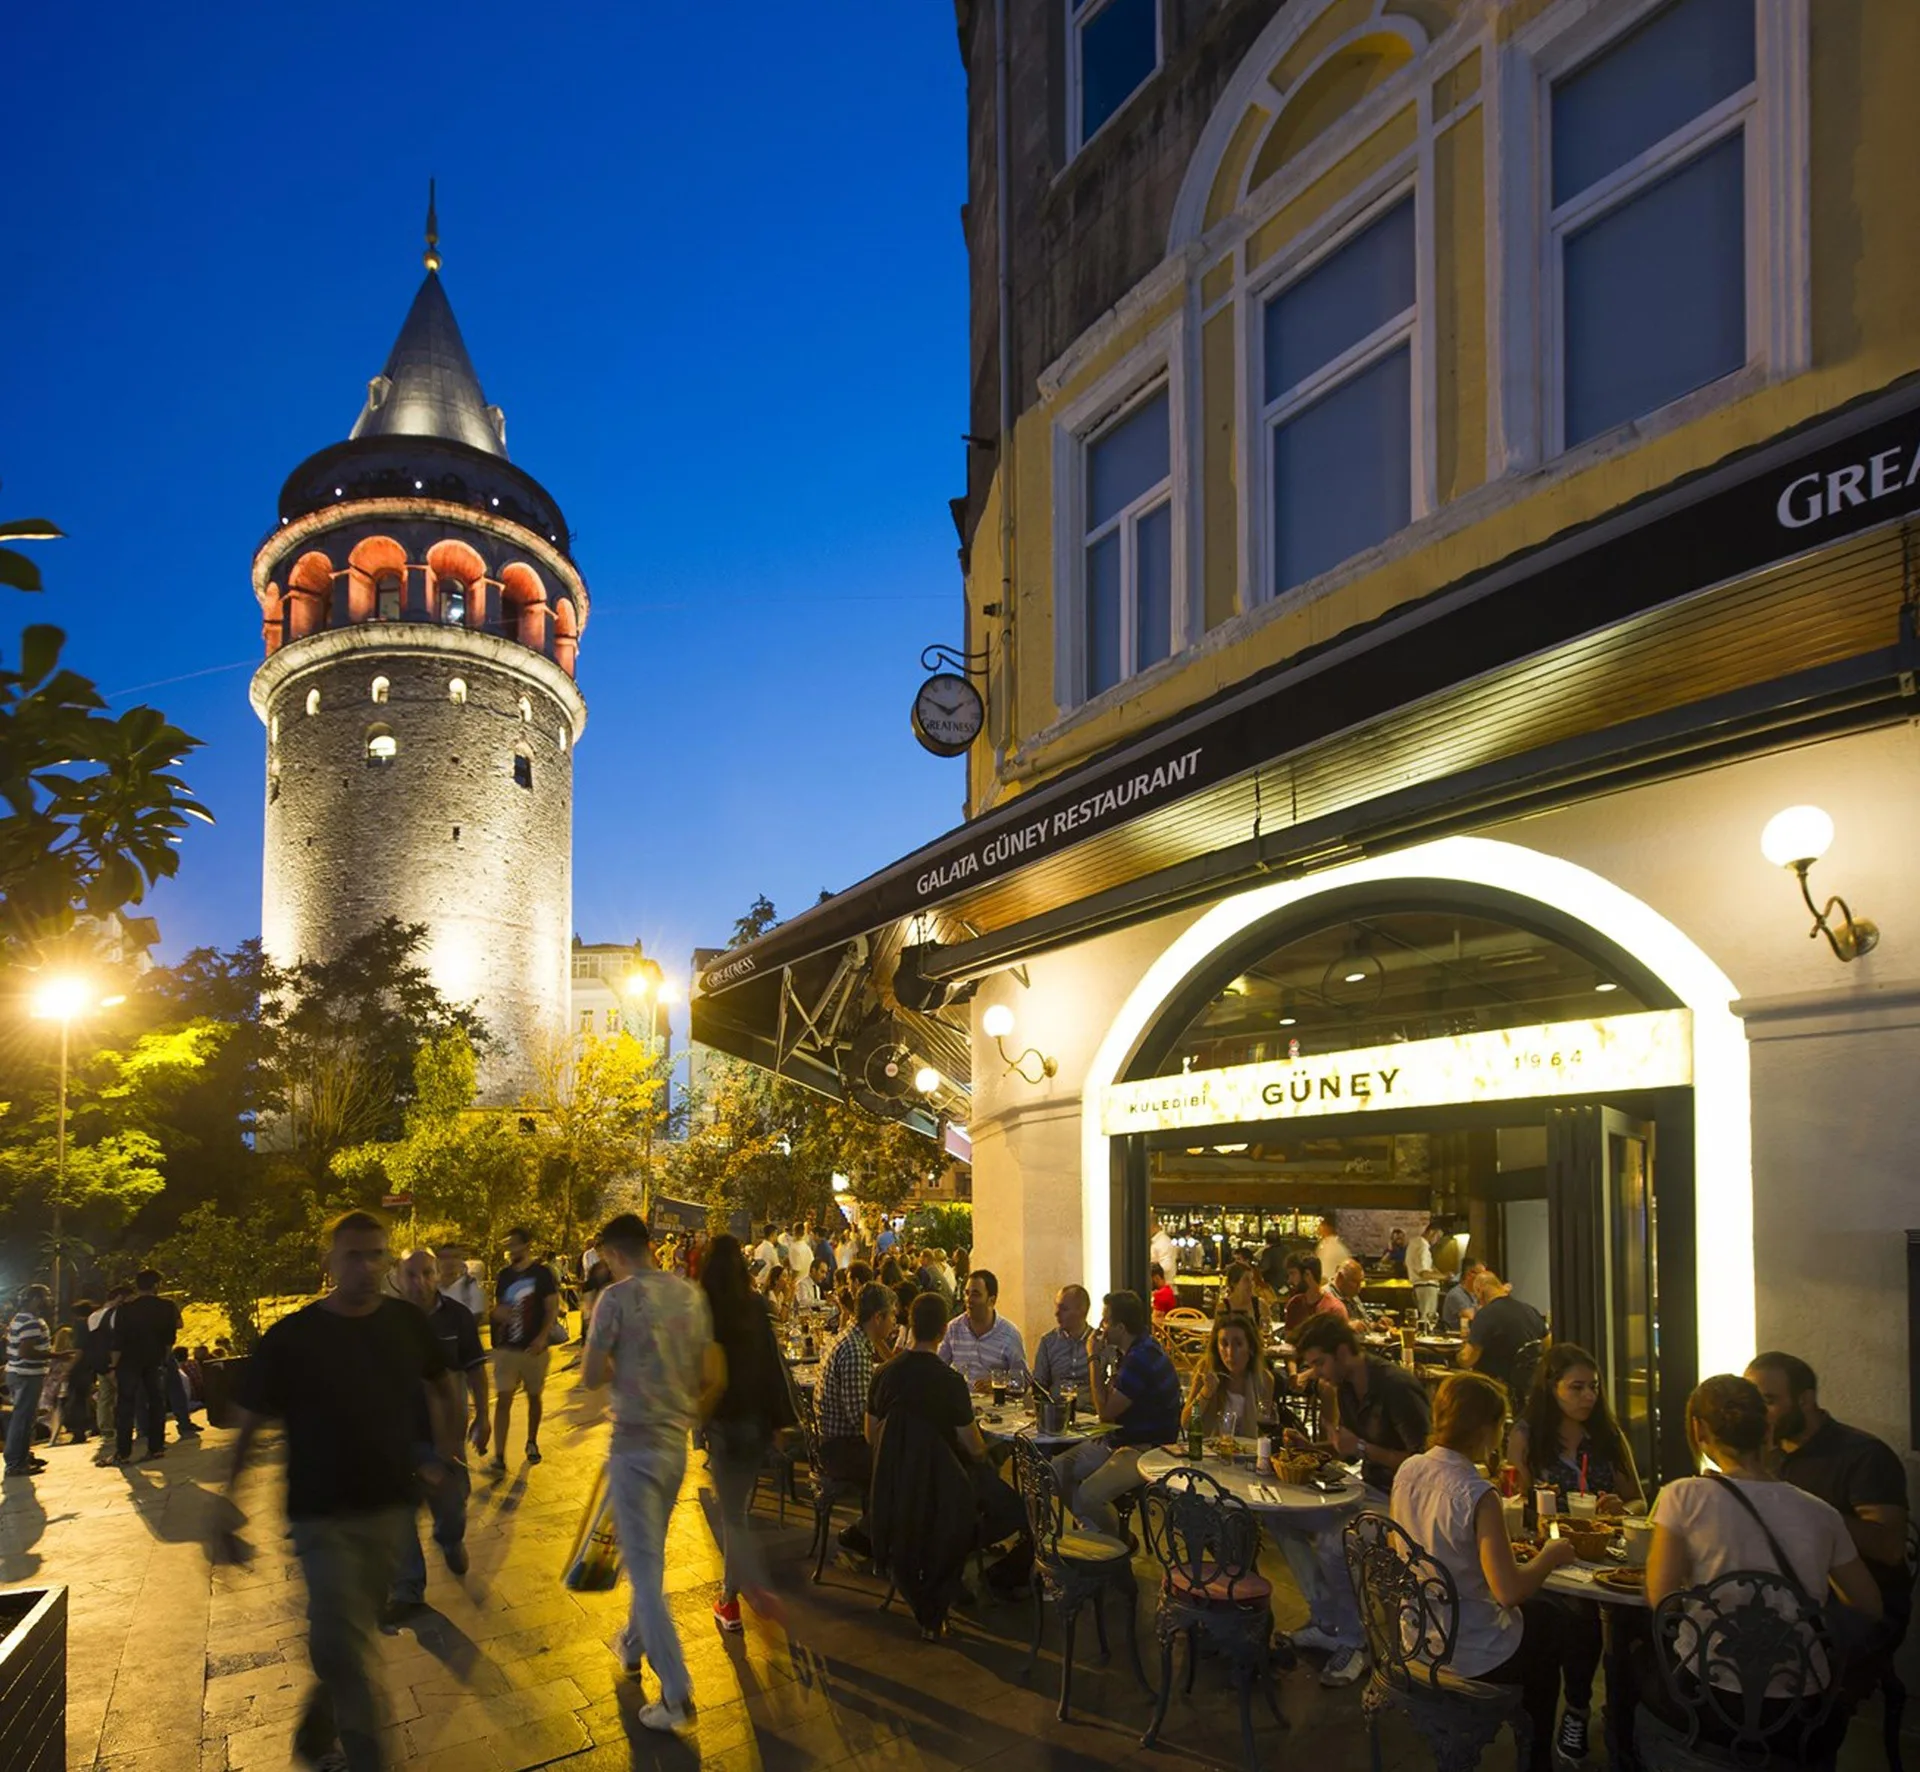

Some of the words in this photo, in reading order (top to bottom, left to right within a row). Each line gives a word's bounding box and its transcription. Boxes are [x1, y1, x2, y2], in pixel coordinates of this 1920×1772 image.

[916, 852, 979, 895] GALATA
[982, 818, 1049, 866] GÜNEY
[1053, 748, 1202, 836] RESTAURANT
[1262, 1069, 1400, 1105] GÜNEY
[1515, 1049, 1582, 1070] 1964
